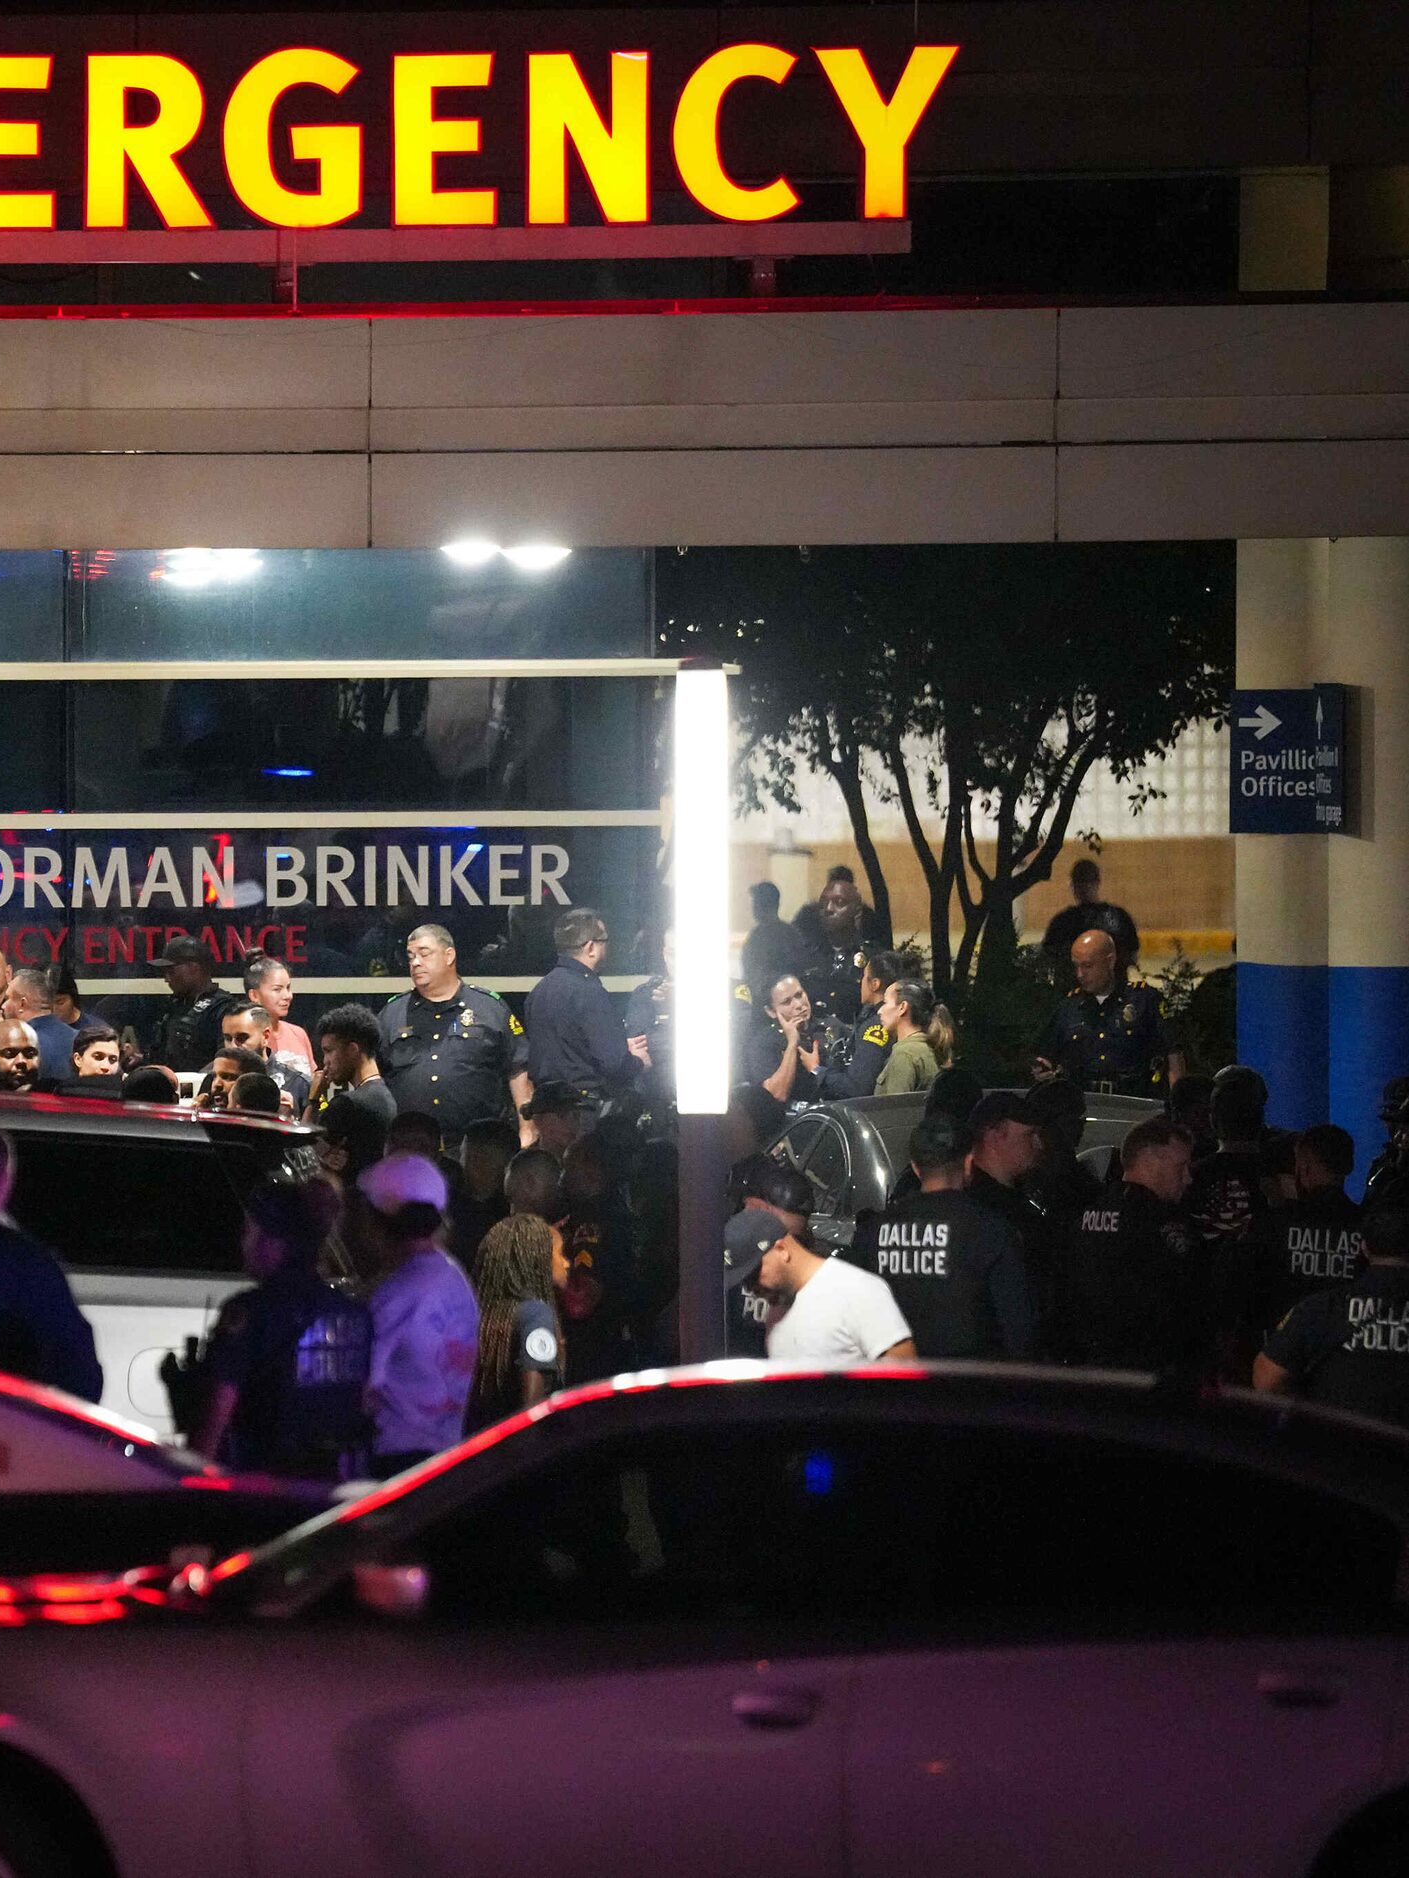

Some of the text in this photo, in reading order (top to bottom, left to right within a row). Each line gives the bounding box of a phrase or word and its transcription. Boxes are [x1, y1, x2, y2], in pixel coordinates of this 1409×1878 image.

[266, 844, 573, 908] BRINKER
[1082, 1210, 1119, 1232] POLICE
[878, 1223, 948, 1247] DALLAS
[1288, 1227, 1362, 1255] DALLAS
[878, 1250, 946, 1274] POLICE
[1292, 1251, 1356, 1278] POLICE
[1348, 1298, 1409, 1325] DALLA
